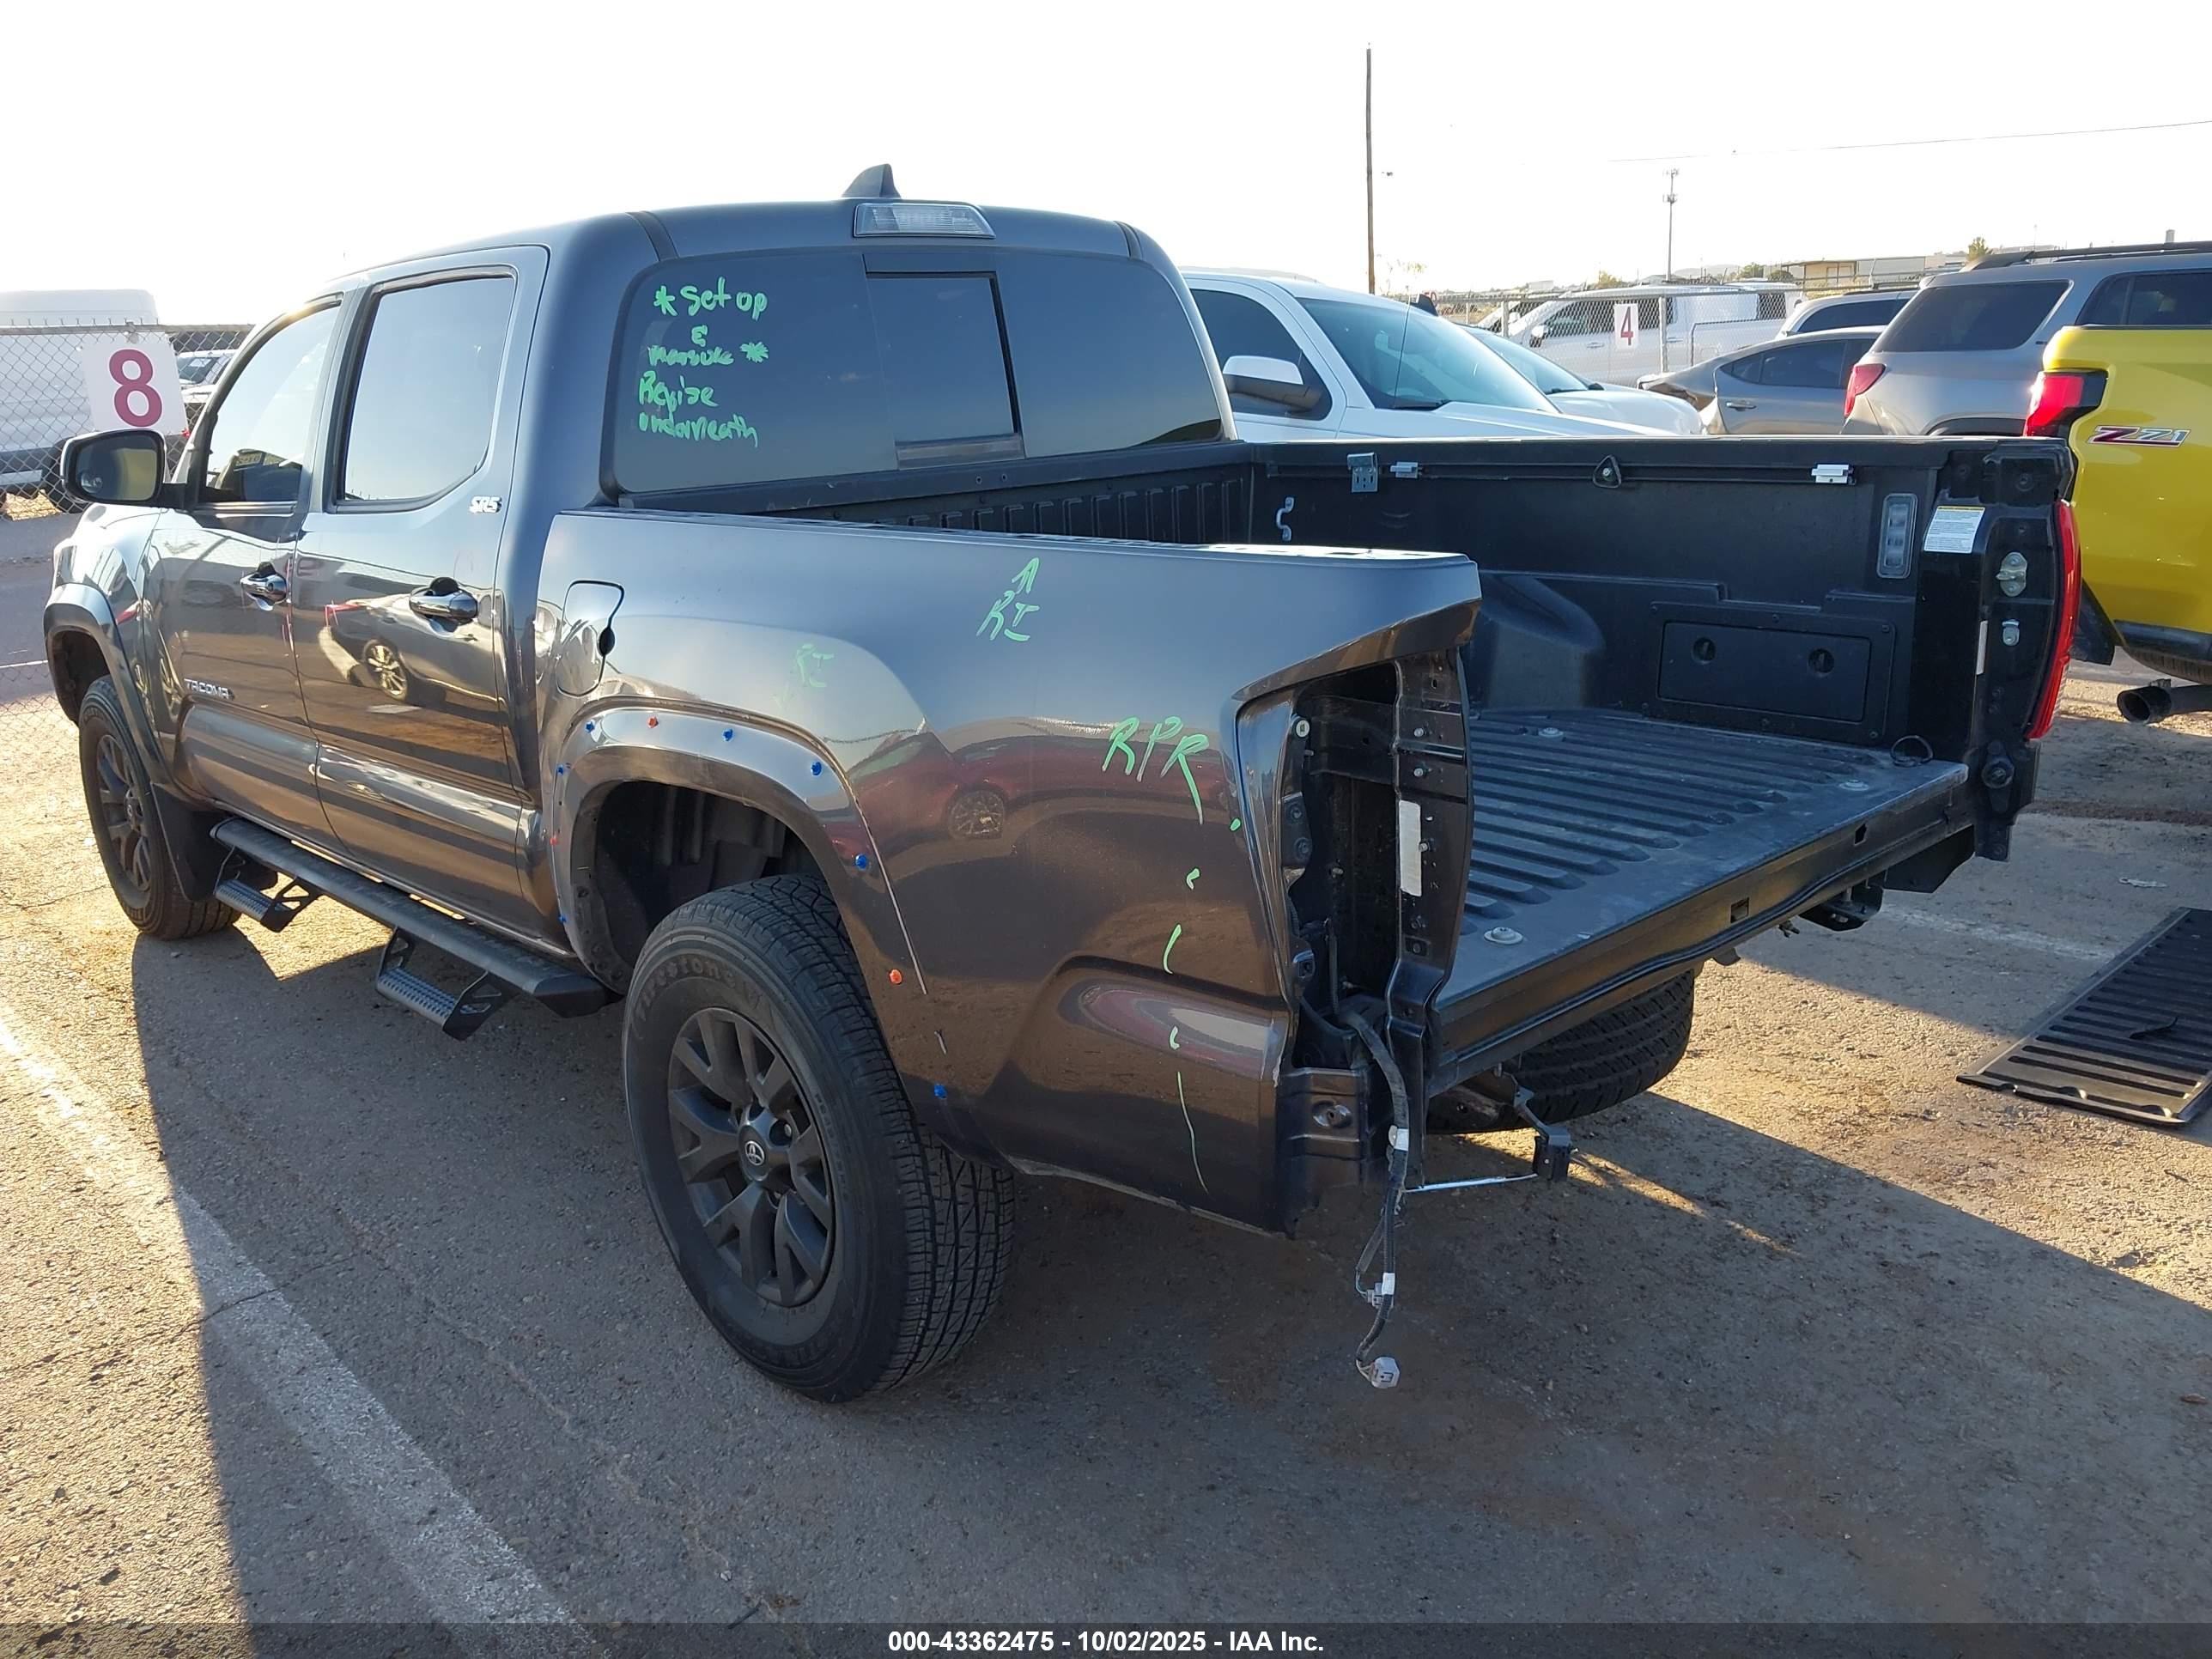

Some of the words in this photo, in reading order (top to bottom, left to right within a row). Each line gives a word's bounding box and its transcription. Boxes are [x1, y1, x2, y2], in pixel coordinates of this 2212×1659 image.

[680, 276, 732, 317] Set
[1620, 306, 1634, 346] 4
[108, 349, 163, 428] 8
[2087, 425, 2191, 447] Z71
[184, 678, 235, 701] TACOMA
[1102, 715, 1210, 825] RPR
